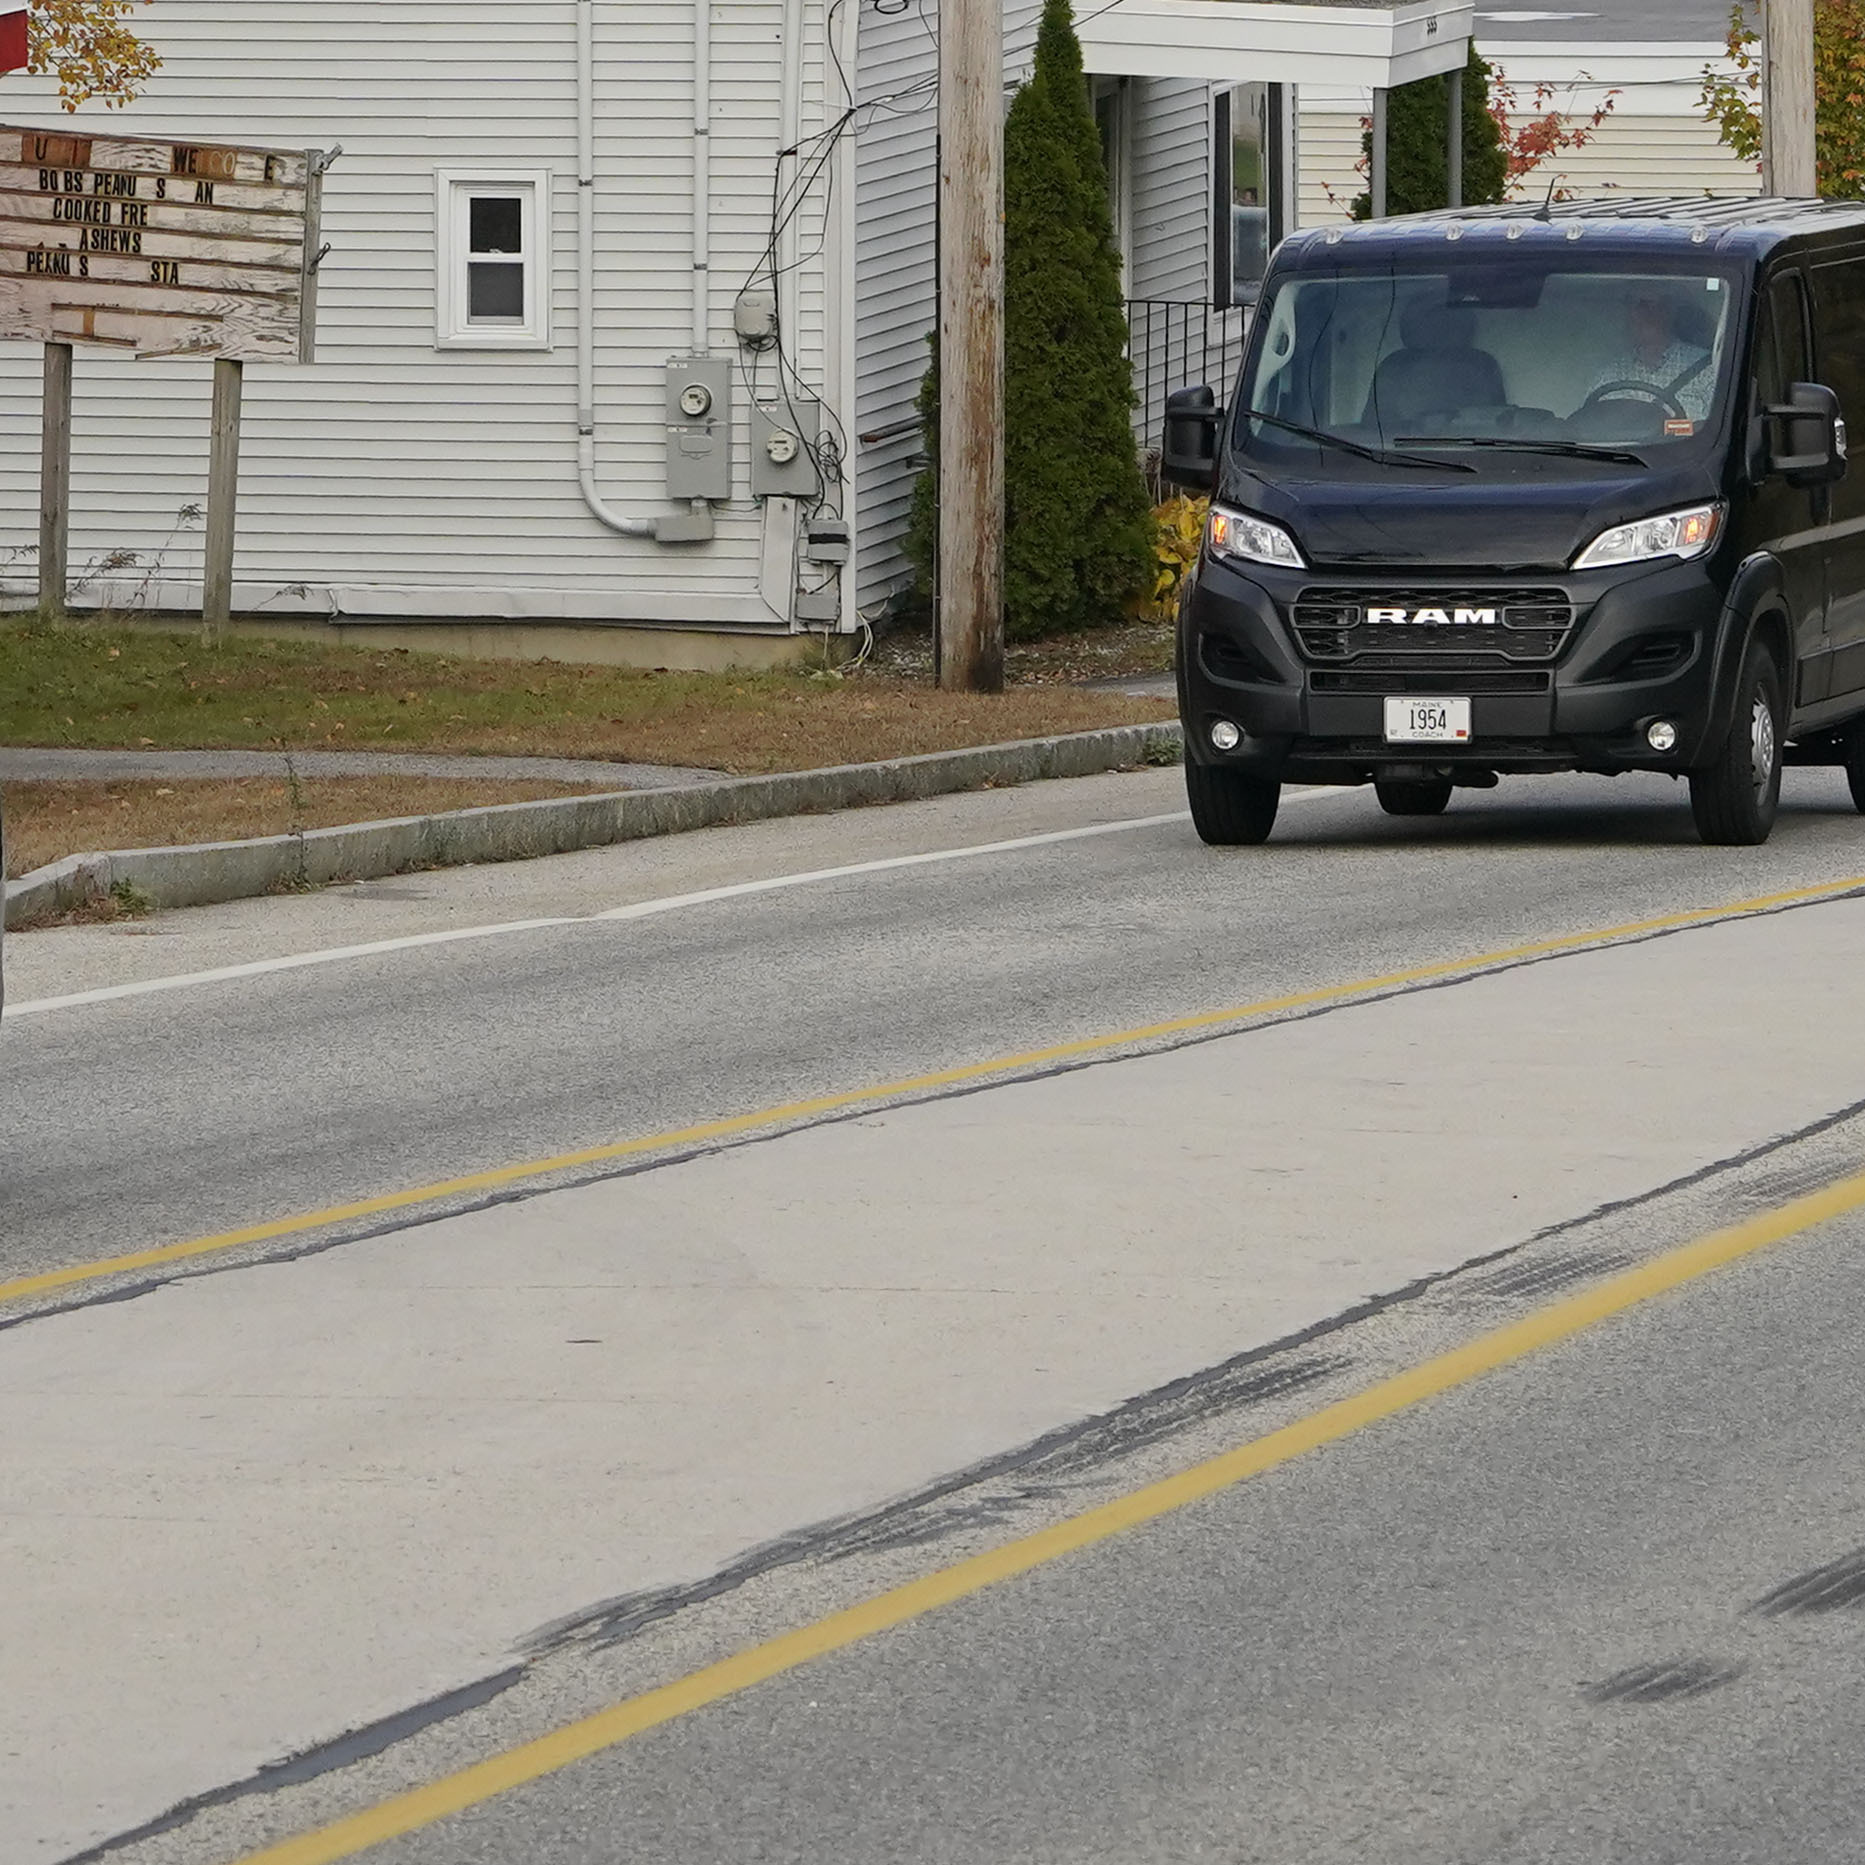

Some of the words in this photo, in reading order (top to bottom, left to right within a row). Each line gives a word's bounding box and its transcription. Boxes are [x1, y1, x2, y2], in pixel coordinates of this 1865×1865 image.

[53, 197, 111, 224] COOKED
[120, 202, 148, 226] FRE
[150, 260, 179, 285] STA
[1367, 608, 1496, 624] RAM
[1409, 709, 1447, 730] 1954
